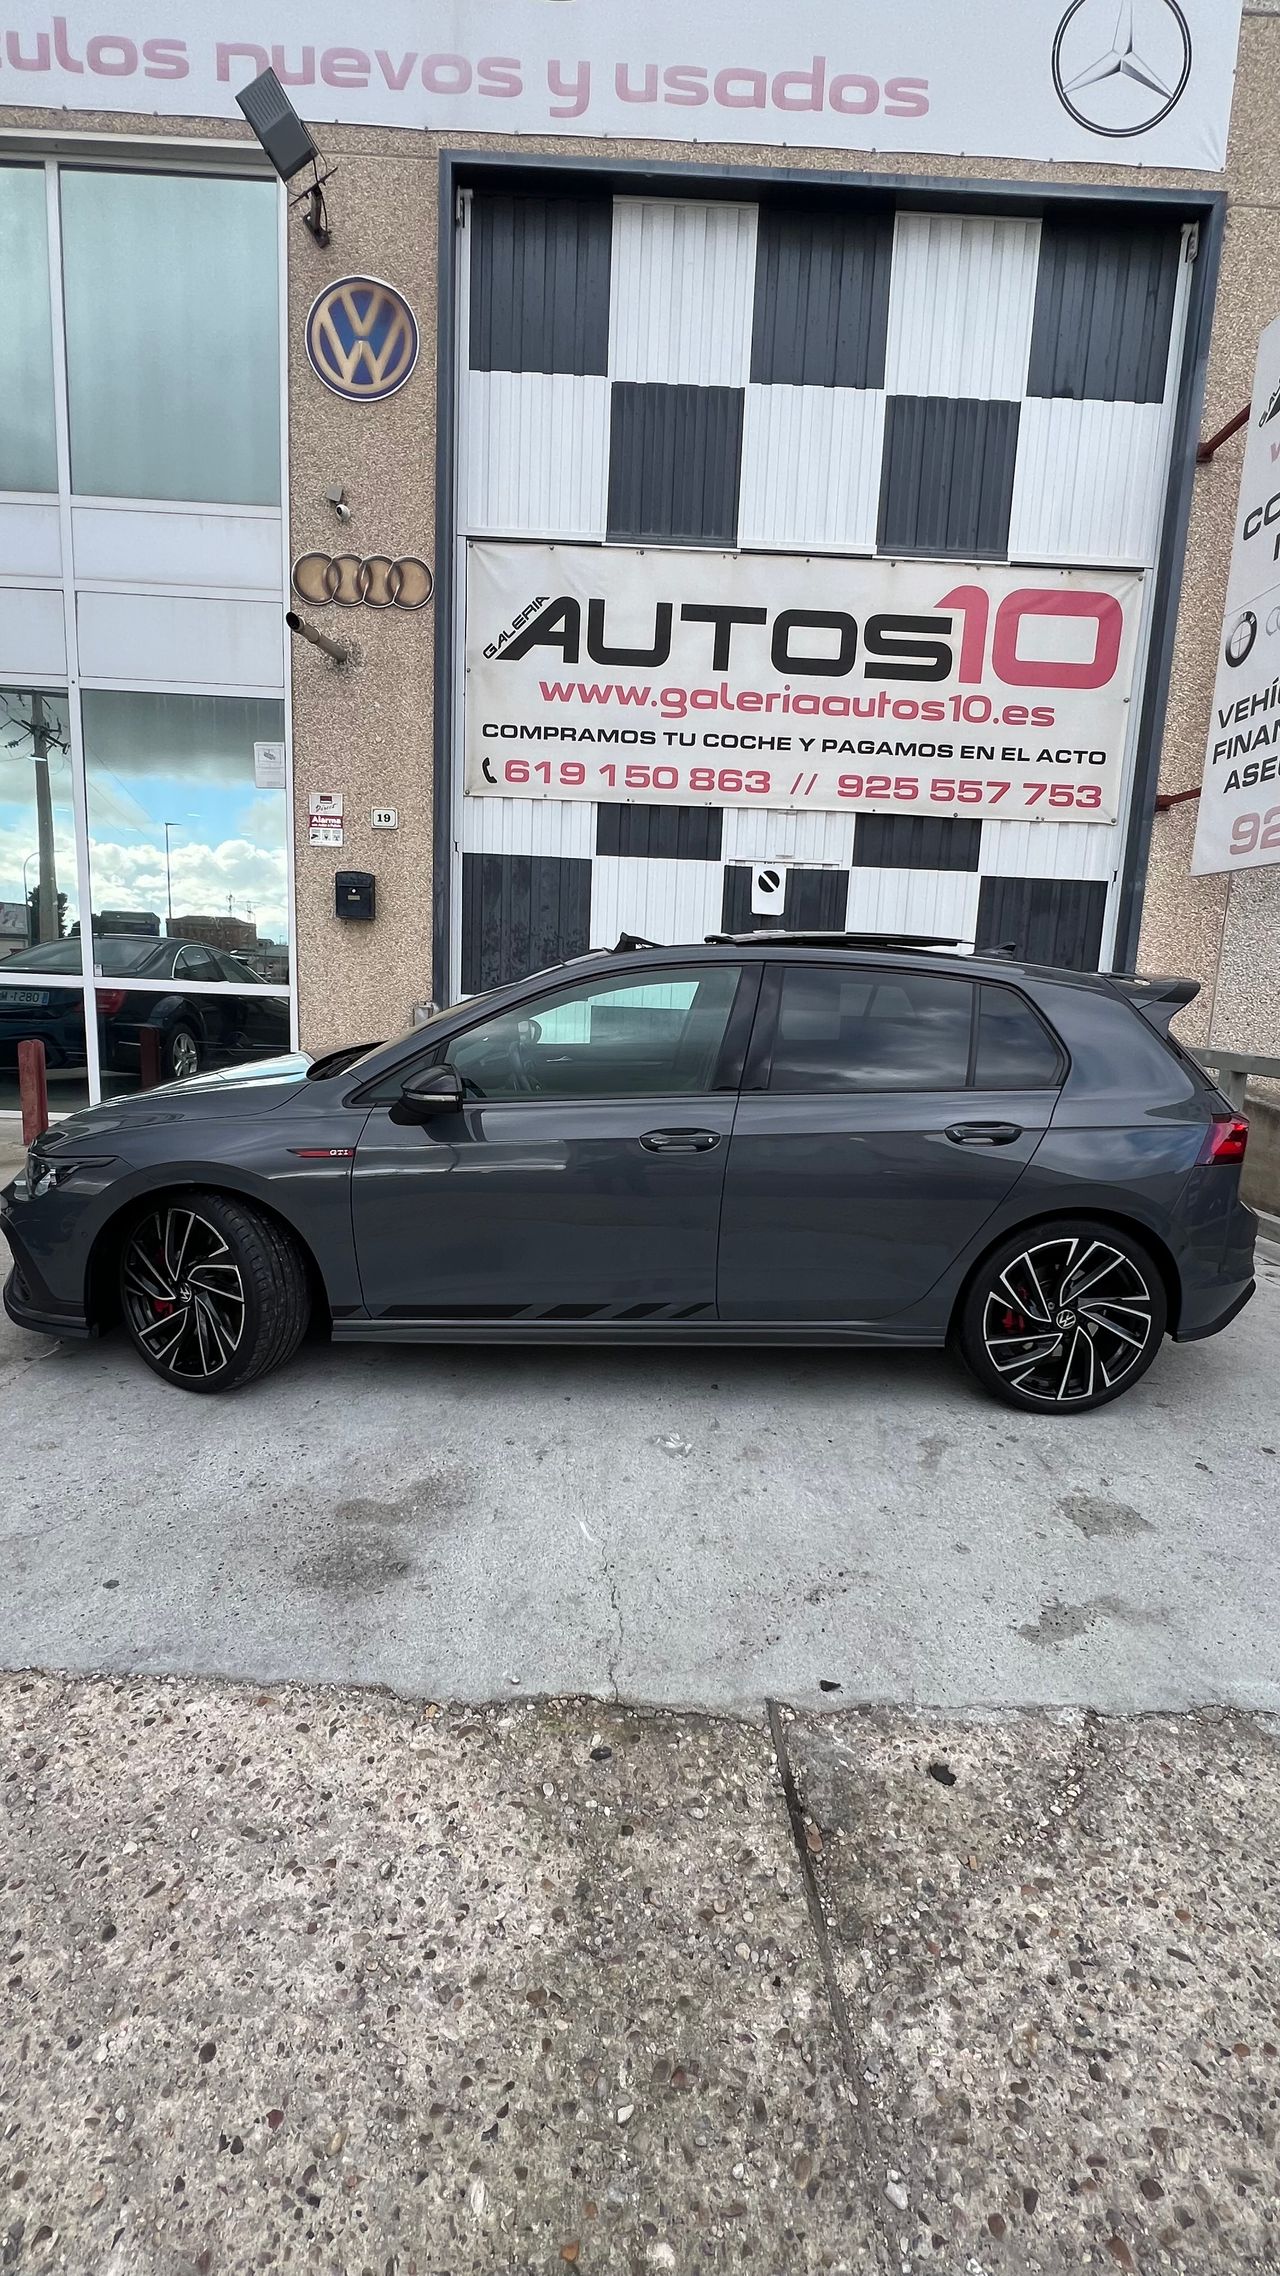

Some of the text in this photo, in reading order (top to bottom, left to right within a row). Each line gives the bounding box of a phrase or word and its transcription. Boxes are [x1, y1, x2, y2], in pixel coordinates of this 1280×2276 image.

[0, 17, 930, 118] ulos nuevos y usados
[483, 597, 550, 659] GALERIA
[539, 681, 1055, 727] www.galeriaautos10.es
[1218, 676, 1280, 729] VEHÍ
[482, 723, 1107, 765] COMPRAMOS TU COCHE Y PAGAMOS EN EL ACTO
[504, 759, 586, 785] 619
[599, 763, 679, 790] 150
[688, 767, 772, 795] 863
[836, 774, 920, 801] 925
[929, 778, 1012, 805] 557
[1022, 782, 1102, 810] 753
[1223, 755, 1280, 794] ASE
[311, 816, 342, 824] Alarma
[377, 813, 391, 823] 19
